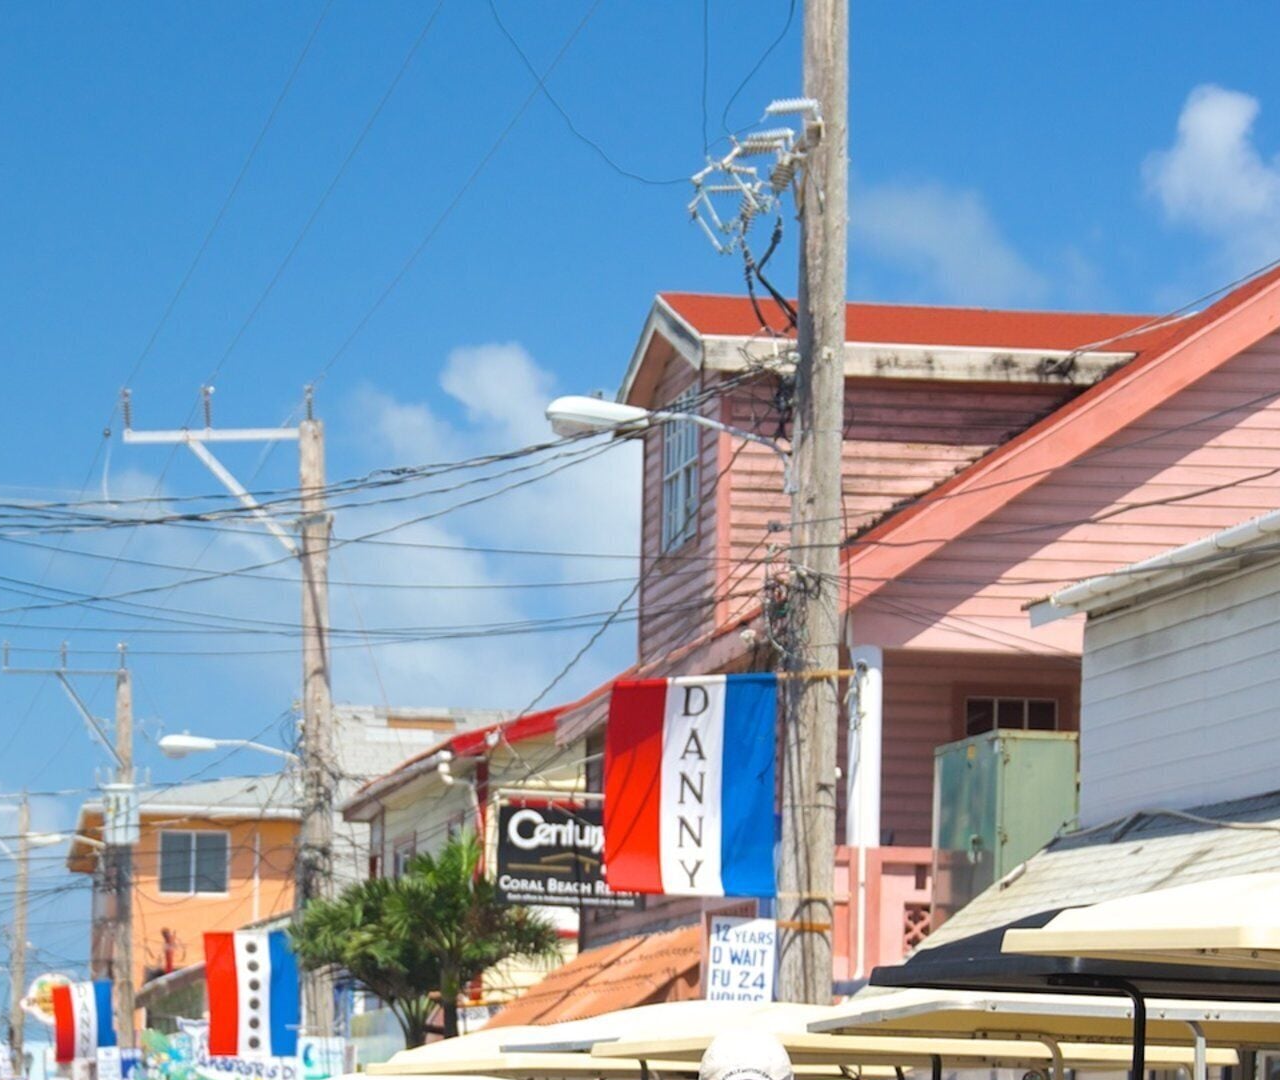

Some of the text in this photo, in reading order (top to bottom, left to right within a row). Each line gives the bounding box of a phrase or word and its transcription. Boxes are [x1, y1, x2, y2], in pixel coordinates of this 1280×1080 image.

[678, 685, 709, 888] DANNY
[500, 874, 545, 891] CORAL
[547, 878, 592, 894] BEACH
[715, 923, 774, 945] 12 YEARS
[729, 947, 767, 967] WAIT
[711, 968, 766, 990] FU 24
